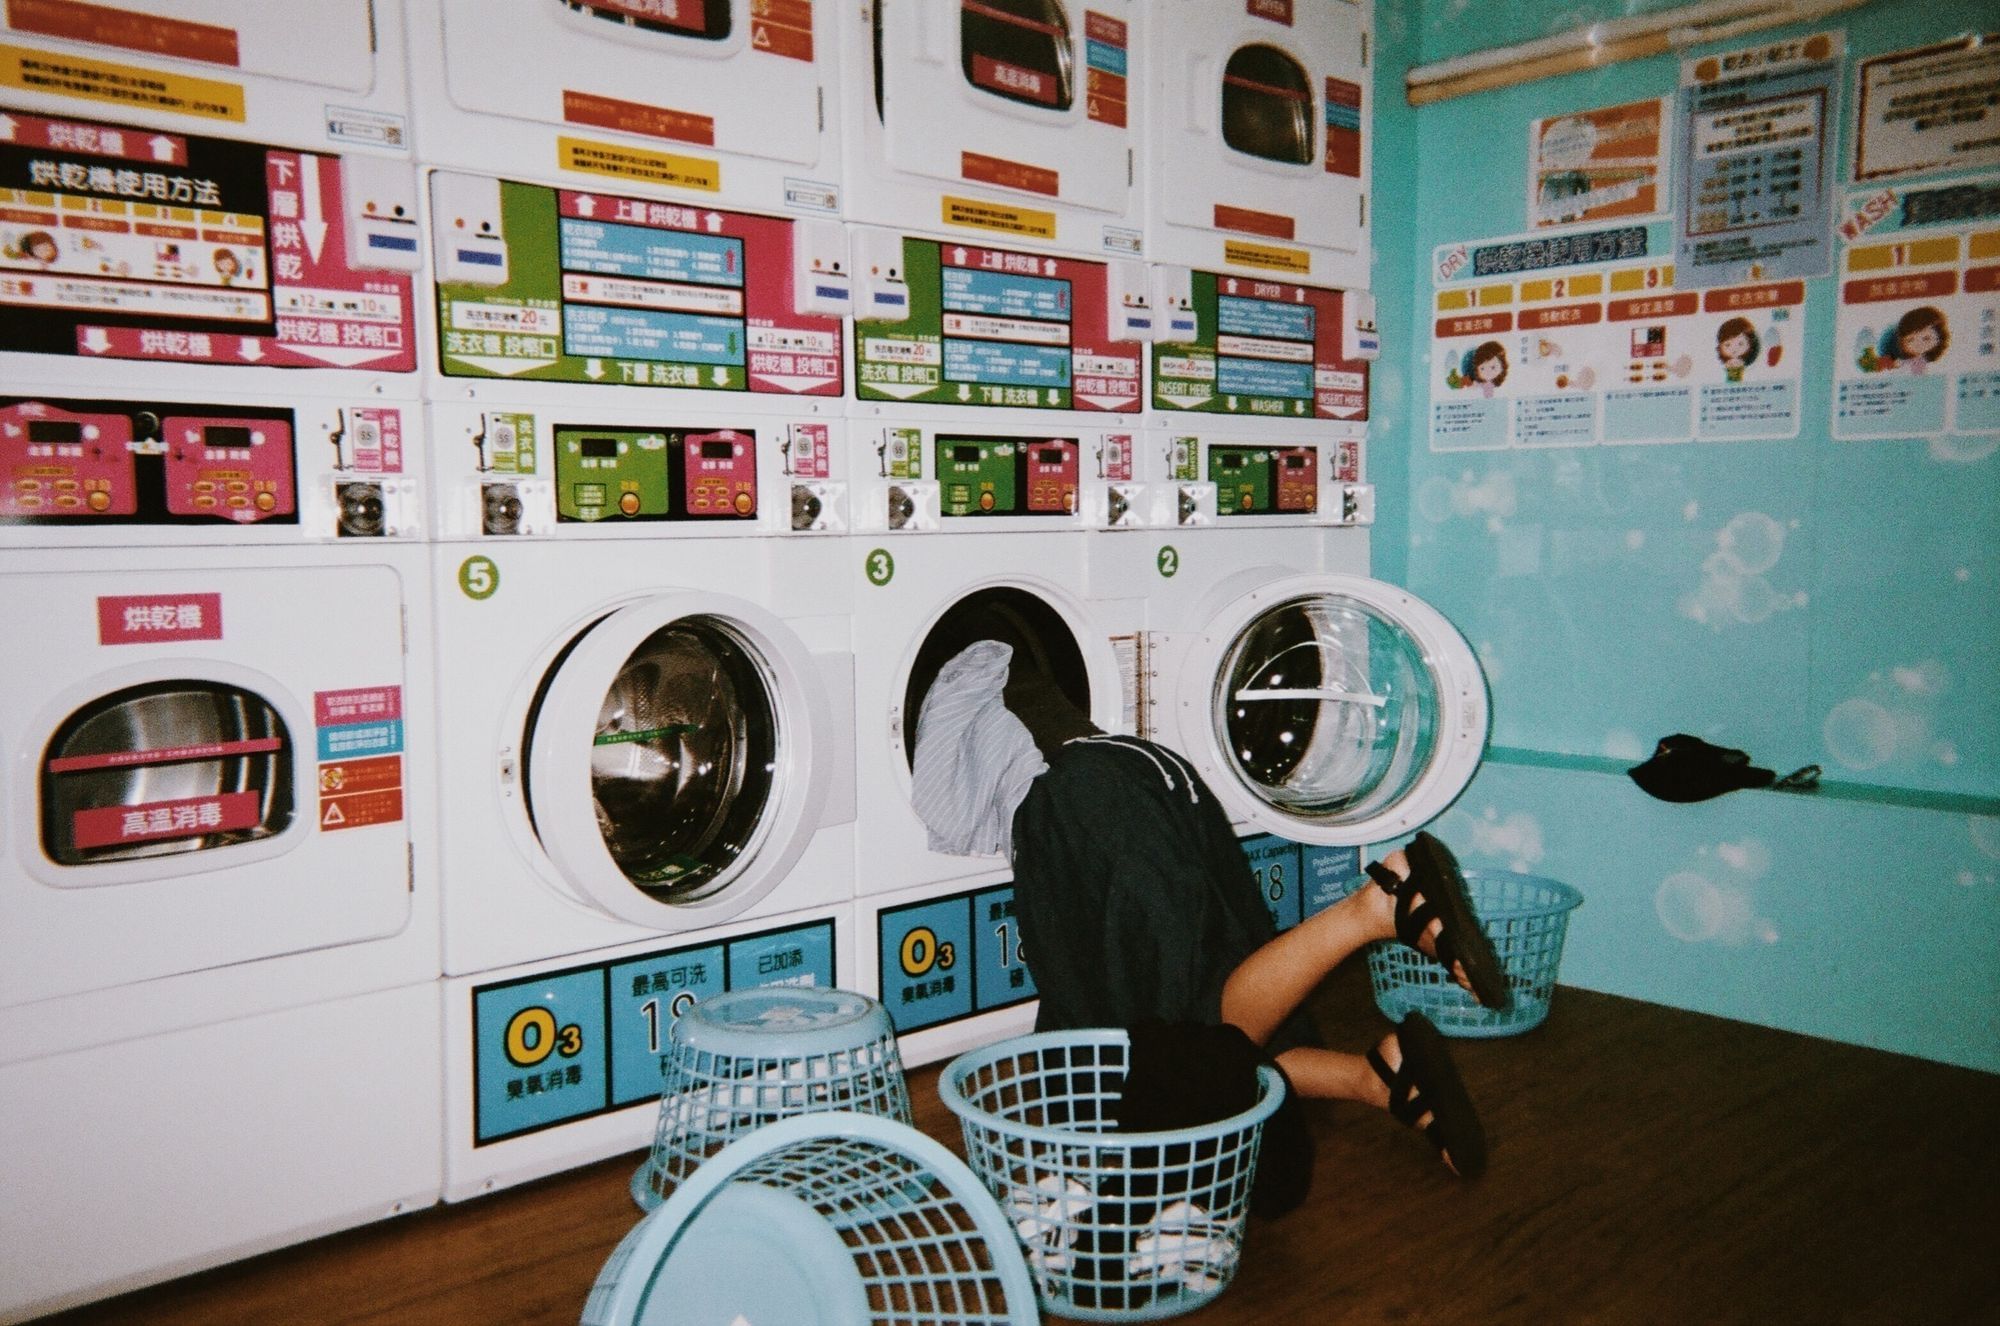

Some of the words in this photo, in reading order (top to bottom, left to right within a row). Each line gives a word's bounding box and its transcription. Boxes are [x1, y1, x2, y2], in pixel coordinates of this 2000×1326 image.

[29, 159, 222, 206] 烘乾機使用方法
[269, 159, 303, 280] 下層烘乾
[650, 205, 697, 230] 烘乾機
[1839, 189, 1897, 241] WASH
[1005, 254, 1038, 275] 烘乾機
[1439, 246, 1468, 279] DRY
[1895, 246, 1904, 265] 1
[1554, 279, 1565, 298] 2
[1647, 268, 1659, 289] 3
[1254, 283, 1281, 298] DRYER
[1469, 290, 1476, 307] 1
[520, 309, 538, 325] 20
[141, 330, 212, 358] 烘乾機
[277, 319, 339, 345] 烘乾機
[343, 324, 402, 347] 投幣口
[447, 331, 500, 354] 洗衣機
[504, 335, 557, 358] 投幣口
[913, 344, 925, 357] 20
[617, 362, 649, 382] 下層
[652, 365, 699, 386] 洗衣機
[751, 353, 795, 374] 烘乾機
[797, 356, 838, 376] 投幣口
[861, 364, 900, 382] 洗衣機
[902, 367, 938, 385] 投幣口
[1005, 388, 1038, 407] 洗衣機
[1075, 378, 1107, 394] 烘乾機
[1108, 380, 1138, 396] 投幣口
[1158, 381, 1188, 396] INSERT
[1190, 384, 1211, 398] HERE
[1250, 399, 1285, 414] WASHER
[872, 554, 889, 580] 3
[1162, 550, 1175, 573] 2
[468, 562, 492, 592] 5
[123, 604, 203, 631] 烘乾機
[122, 802, 223, 837] 高溫消毒
[1253, 864, 1284, 903] 18
[632, 963, 708, 998] 最高可洗
